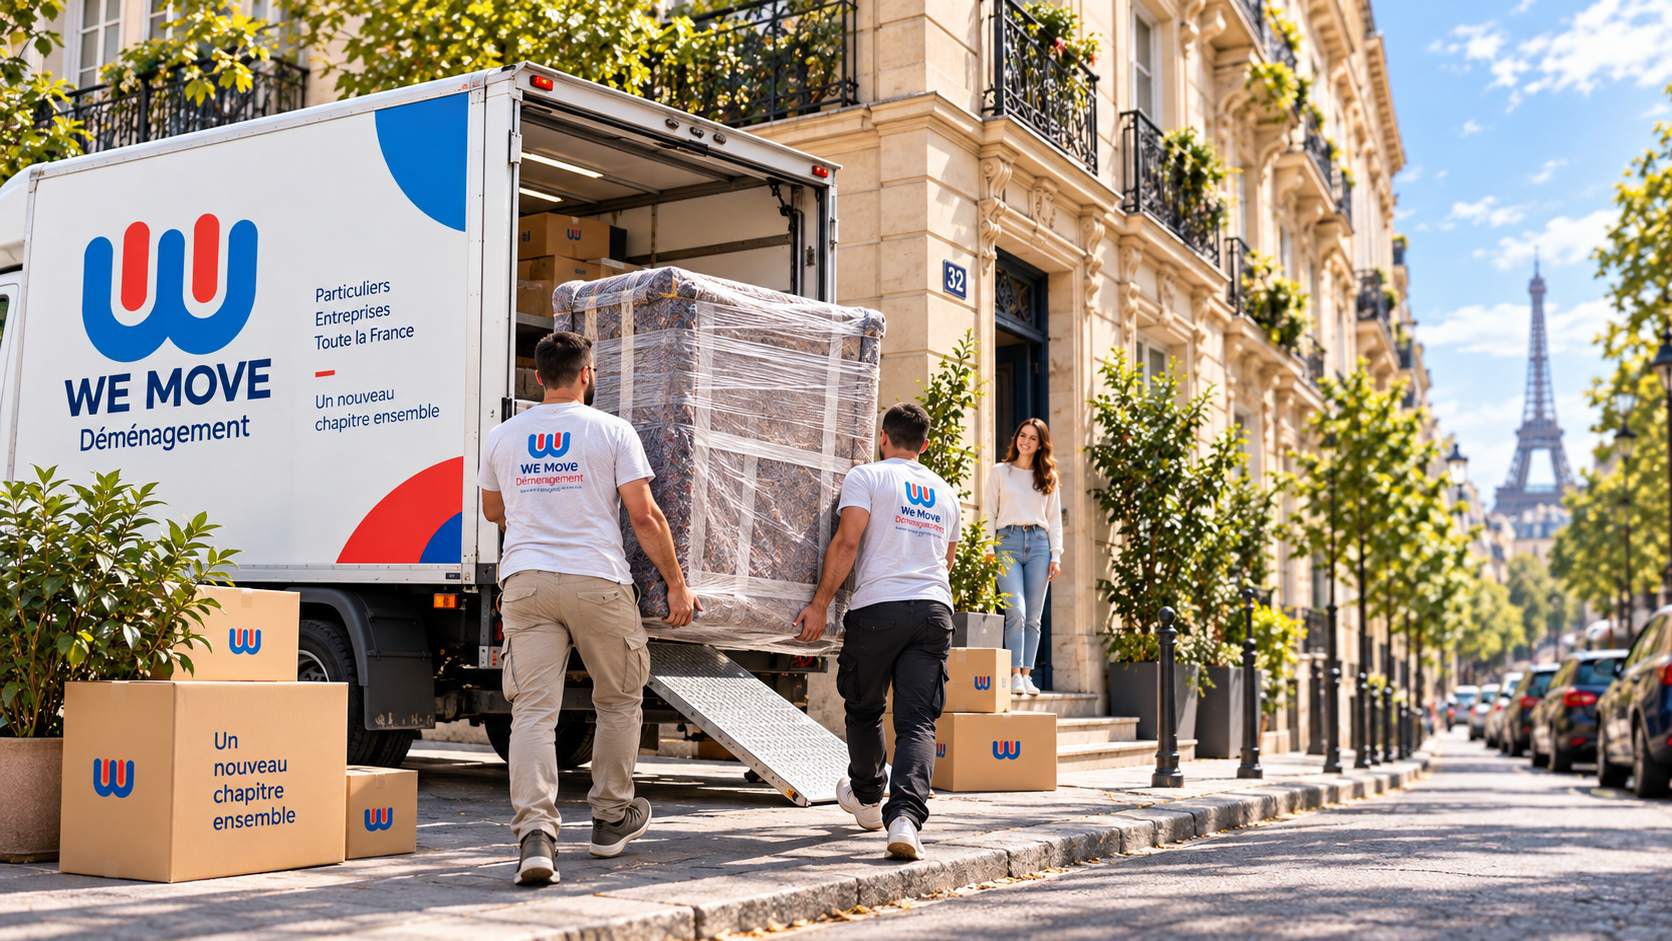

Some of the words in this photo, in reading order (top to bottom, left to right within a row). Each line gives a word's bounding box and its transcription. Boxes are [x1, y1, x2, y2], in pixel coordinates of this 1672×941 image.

[315, 280, 390, 303] Particuliers
[947, 266, 963, 293] 32
[315, 303, 391, 327] Entreprises
[314, 333, 352, 350] Toute
[355, 330, 367, 346] la
[370, 324, 415, 343] France
[64, 373, 132, 417] WE
[145, 358, 272, 410] MOVE
[315, 394, 334, 410] Un
[337, 388, 394, 407] nouveau
[315, 411, 370, 433] chapitre
[373, 403, 440, 425] ensemble
[80, 415, 250, 452] Déménagement
[520, 463, 540, 474] WE
[901, 505, 915, 517] We
[916, 509, 941, 523] Move
[214, 732, 239, 750] Un
[213, 758, 288, 777] nouveau
[213, 781, 285, 806] chapitre
[213, 805, 297, 831] ensemble
